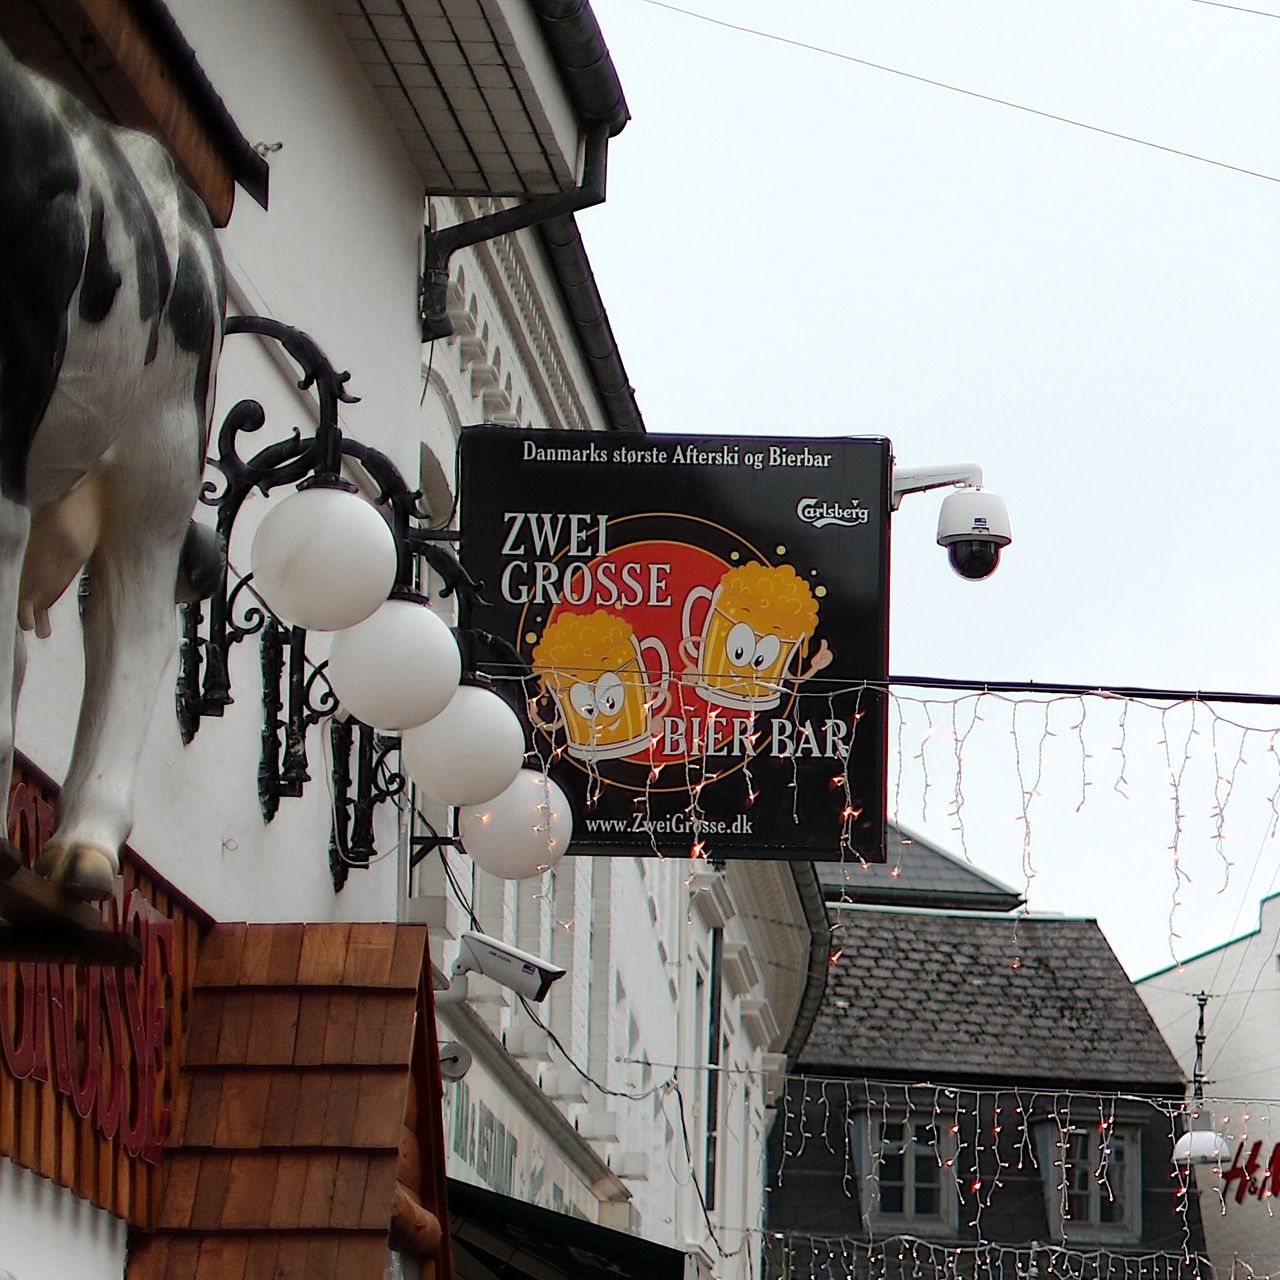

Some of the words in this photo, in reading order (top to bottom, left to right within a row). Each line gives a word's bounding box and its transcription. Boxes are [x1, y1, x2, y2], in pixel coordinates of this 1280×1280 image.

[523, 440, 608, 464] Danmarks
[612, 447, 668, 465] største
[672, 445, 739, 466] Afterski
[744, 451, 763, 470] og
[768, 446, 832, 468] Bierbar
[796, 498, 870, 529] Carlsberg
[501, 512, 609, 557] ZWEI
[501, 561, 673, 607] GROSSE
[662, 716, 756, 757] BIER
[770, 717, 850, 758] BAR
[585, 812, 754, 835] www.ZweiGrosse.dk
